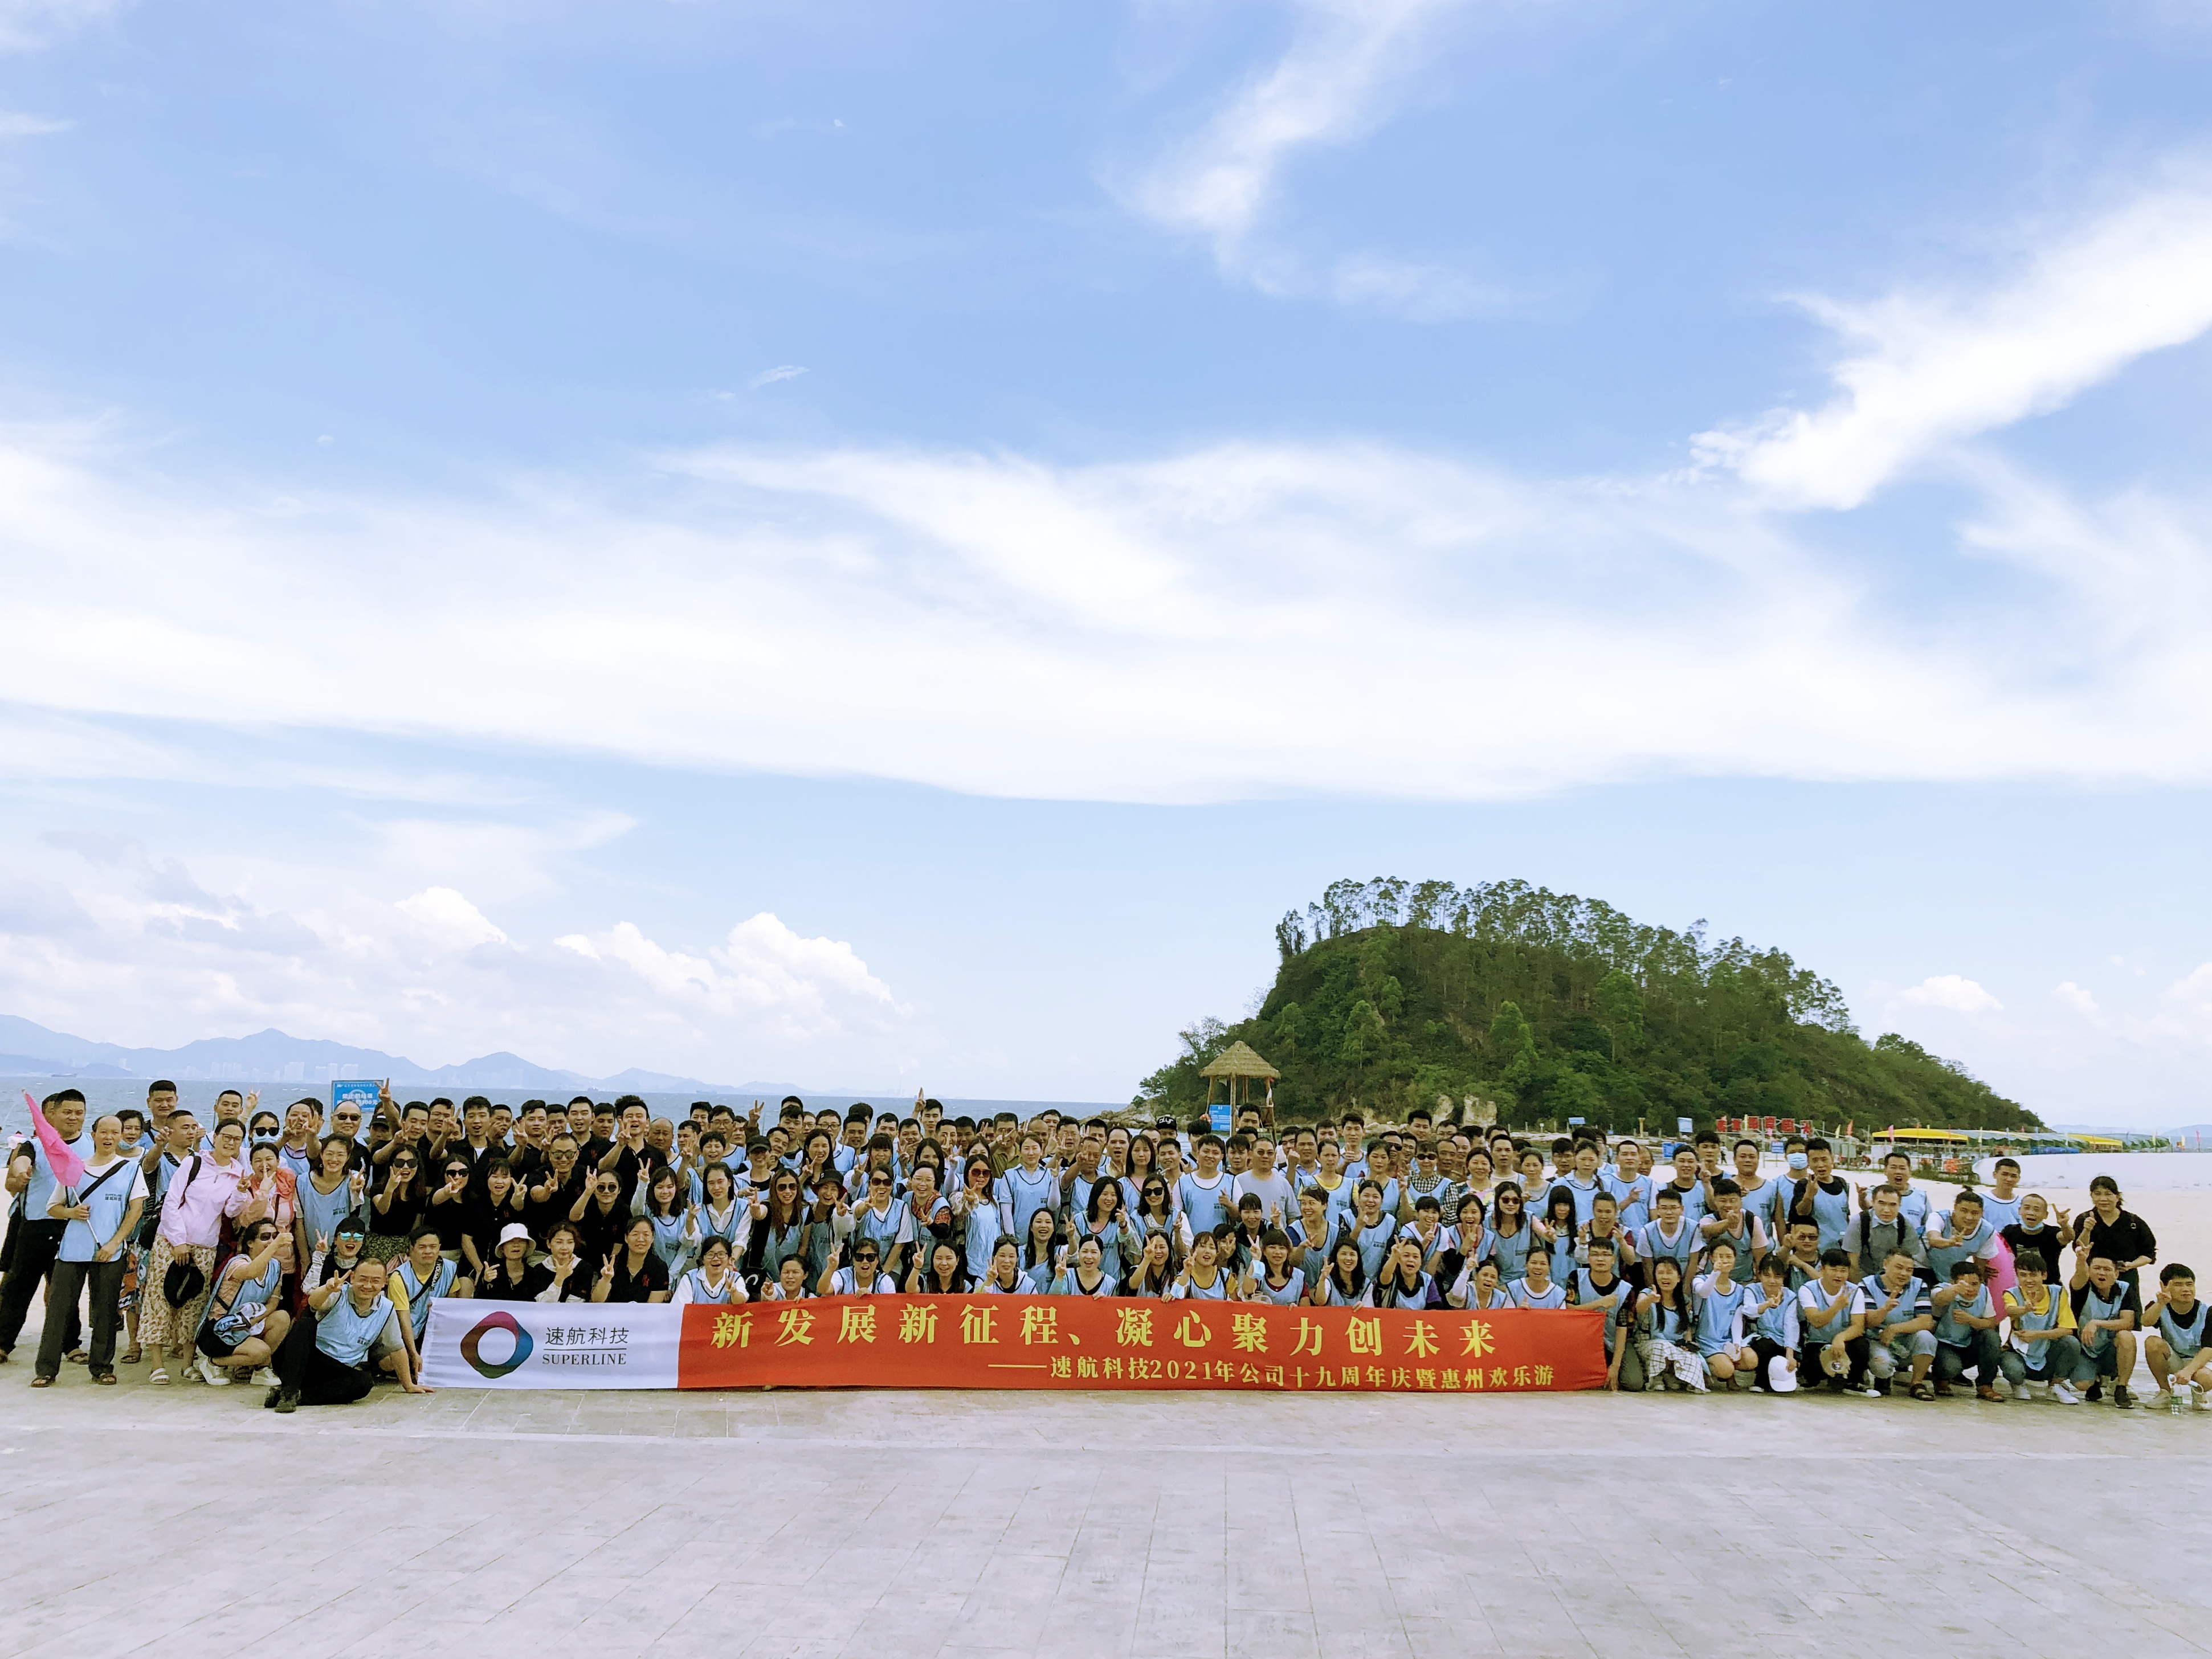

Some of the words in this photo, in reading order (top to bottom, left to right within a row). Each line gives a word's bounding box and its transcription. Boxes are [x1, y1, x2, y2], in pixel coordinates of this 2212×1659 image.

[545, 1327, 629, 1346] 速航科技
[711, 1304, 1496, 1359] 新发展新征程、凝心聚力创未来
[542, 1353, 627, 1366] SUPERLINE
